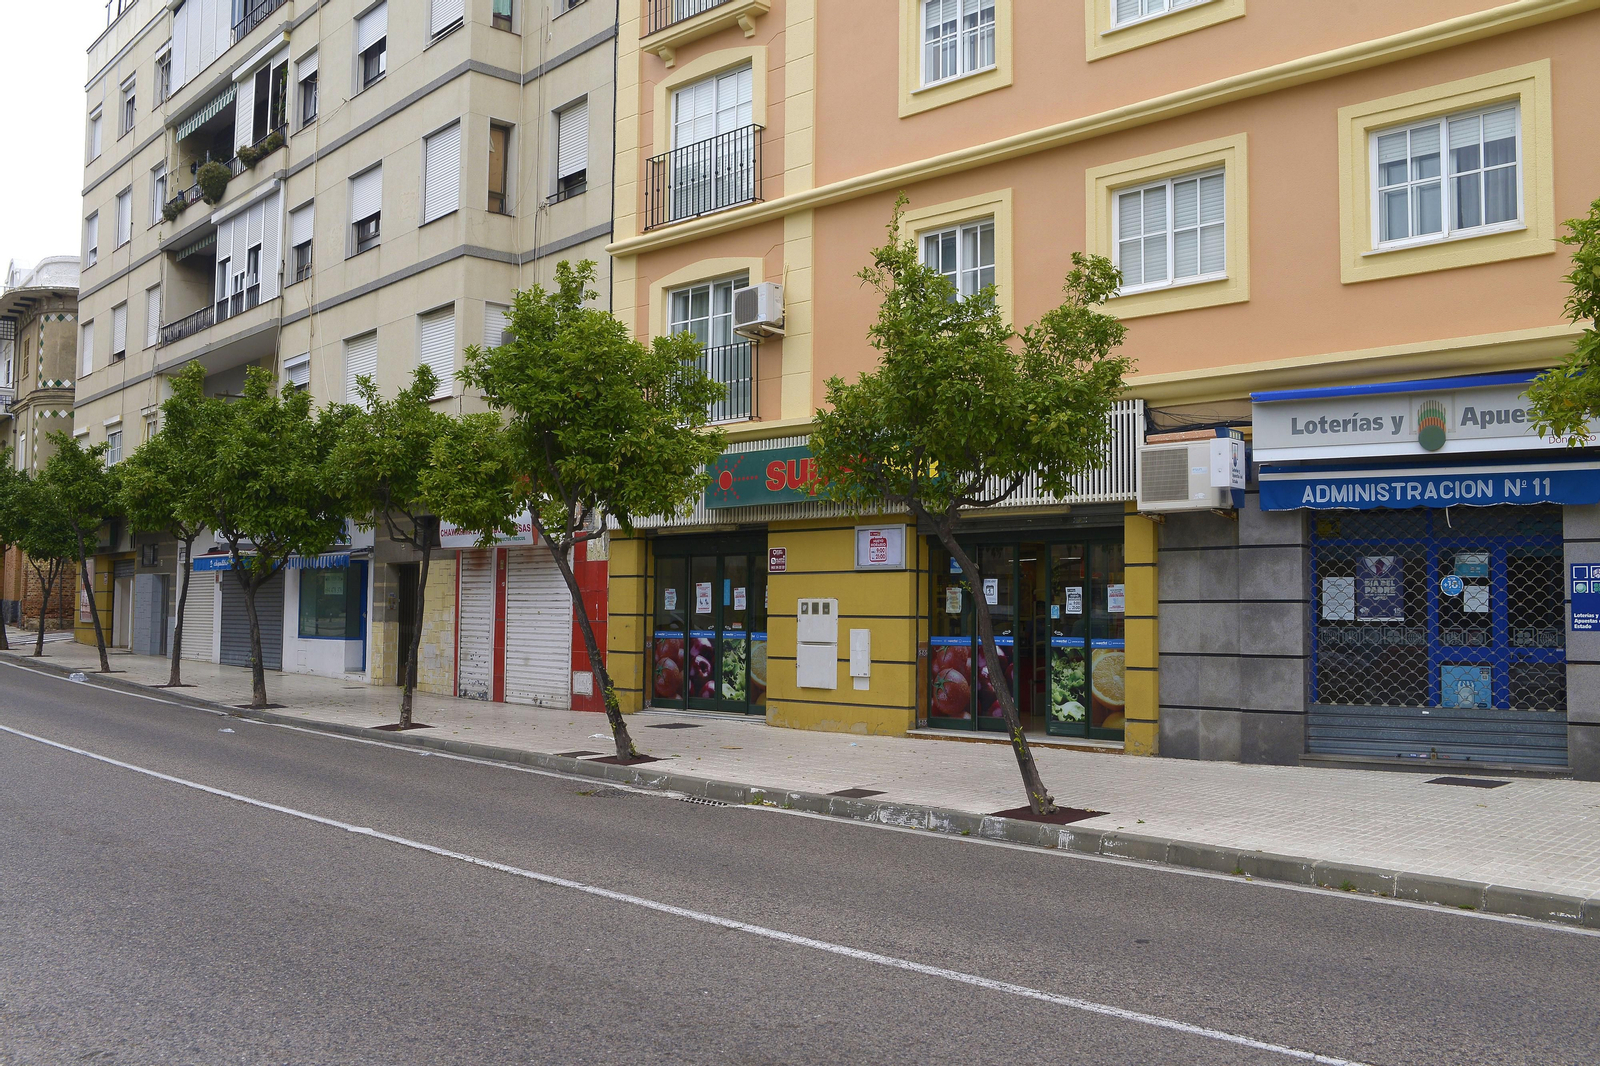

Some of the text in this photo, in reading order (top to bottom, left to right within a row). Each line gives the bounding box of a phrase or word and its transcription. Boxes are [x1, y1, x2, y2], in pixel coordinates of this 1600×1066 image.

[1291, 412, 1384, 435] Loterías
[1390, 415, 1404, 435] y
[1302, 479, 1493, 503] ADMINISTRACION
[1532, 477, 1550, 496] 11
